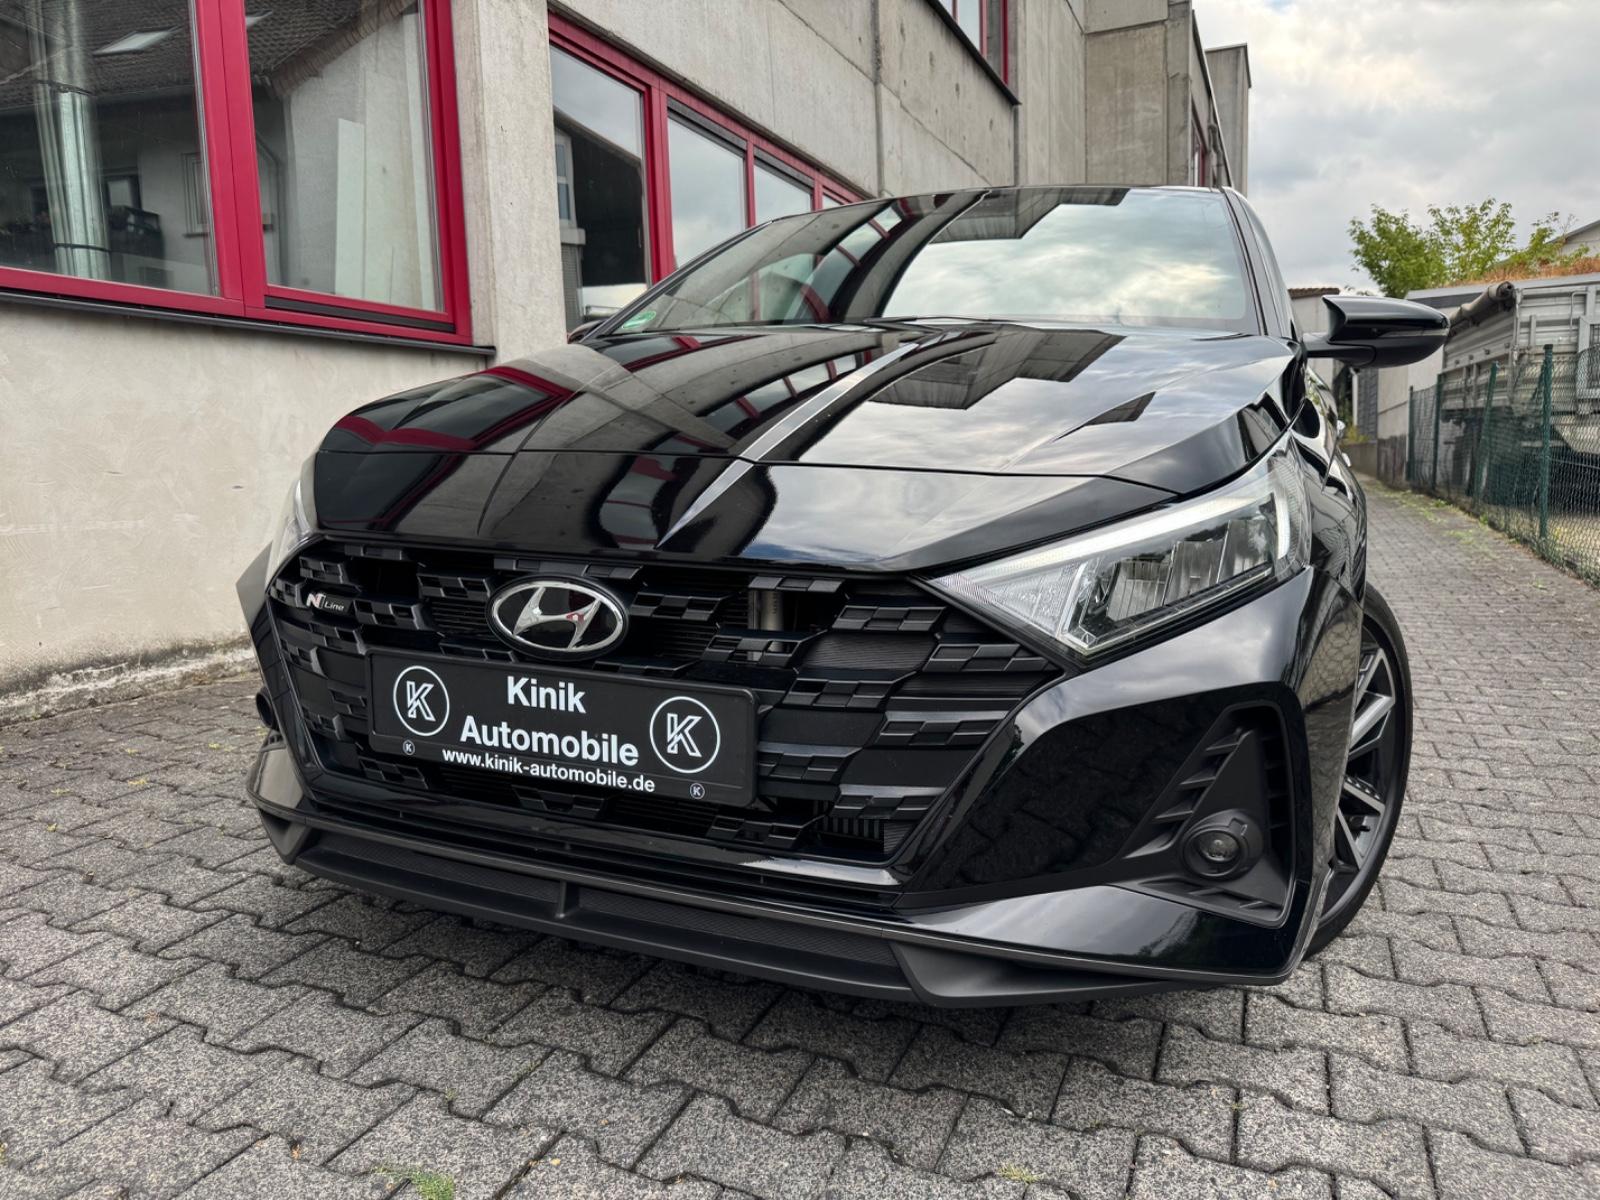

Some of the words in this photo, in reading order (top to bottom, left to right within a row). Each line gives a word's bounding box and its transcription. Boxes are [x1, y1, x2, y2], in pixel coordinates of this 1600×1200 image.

[324, 601, 345, 611] Line
[507, 675, 586, 714] Kinik
[459, 714, 640, 767] Automobile
[441, 748, 656, 793] www.kinik-automobile.de
